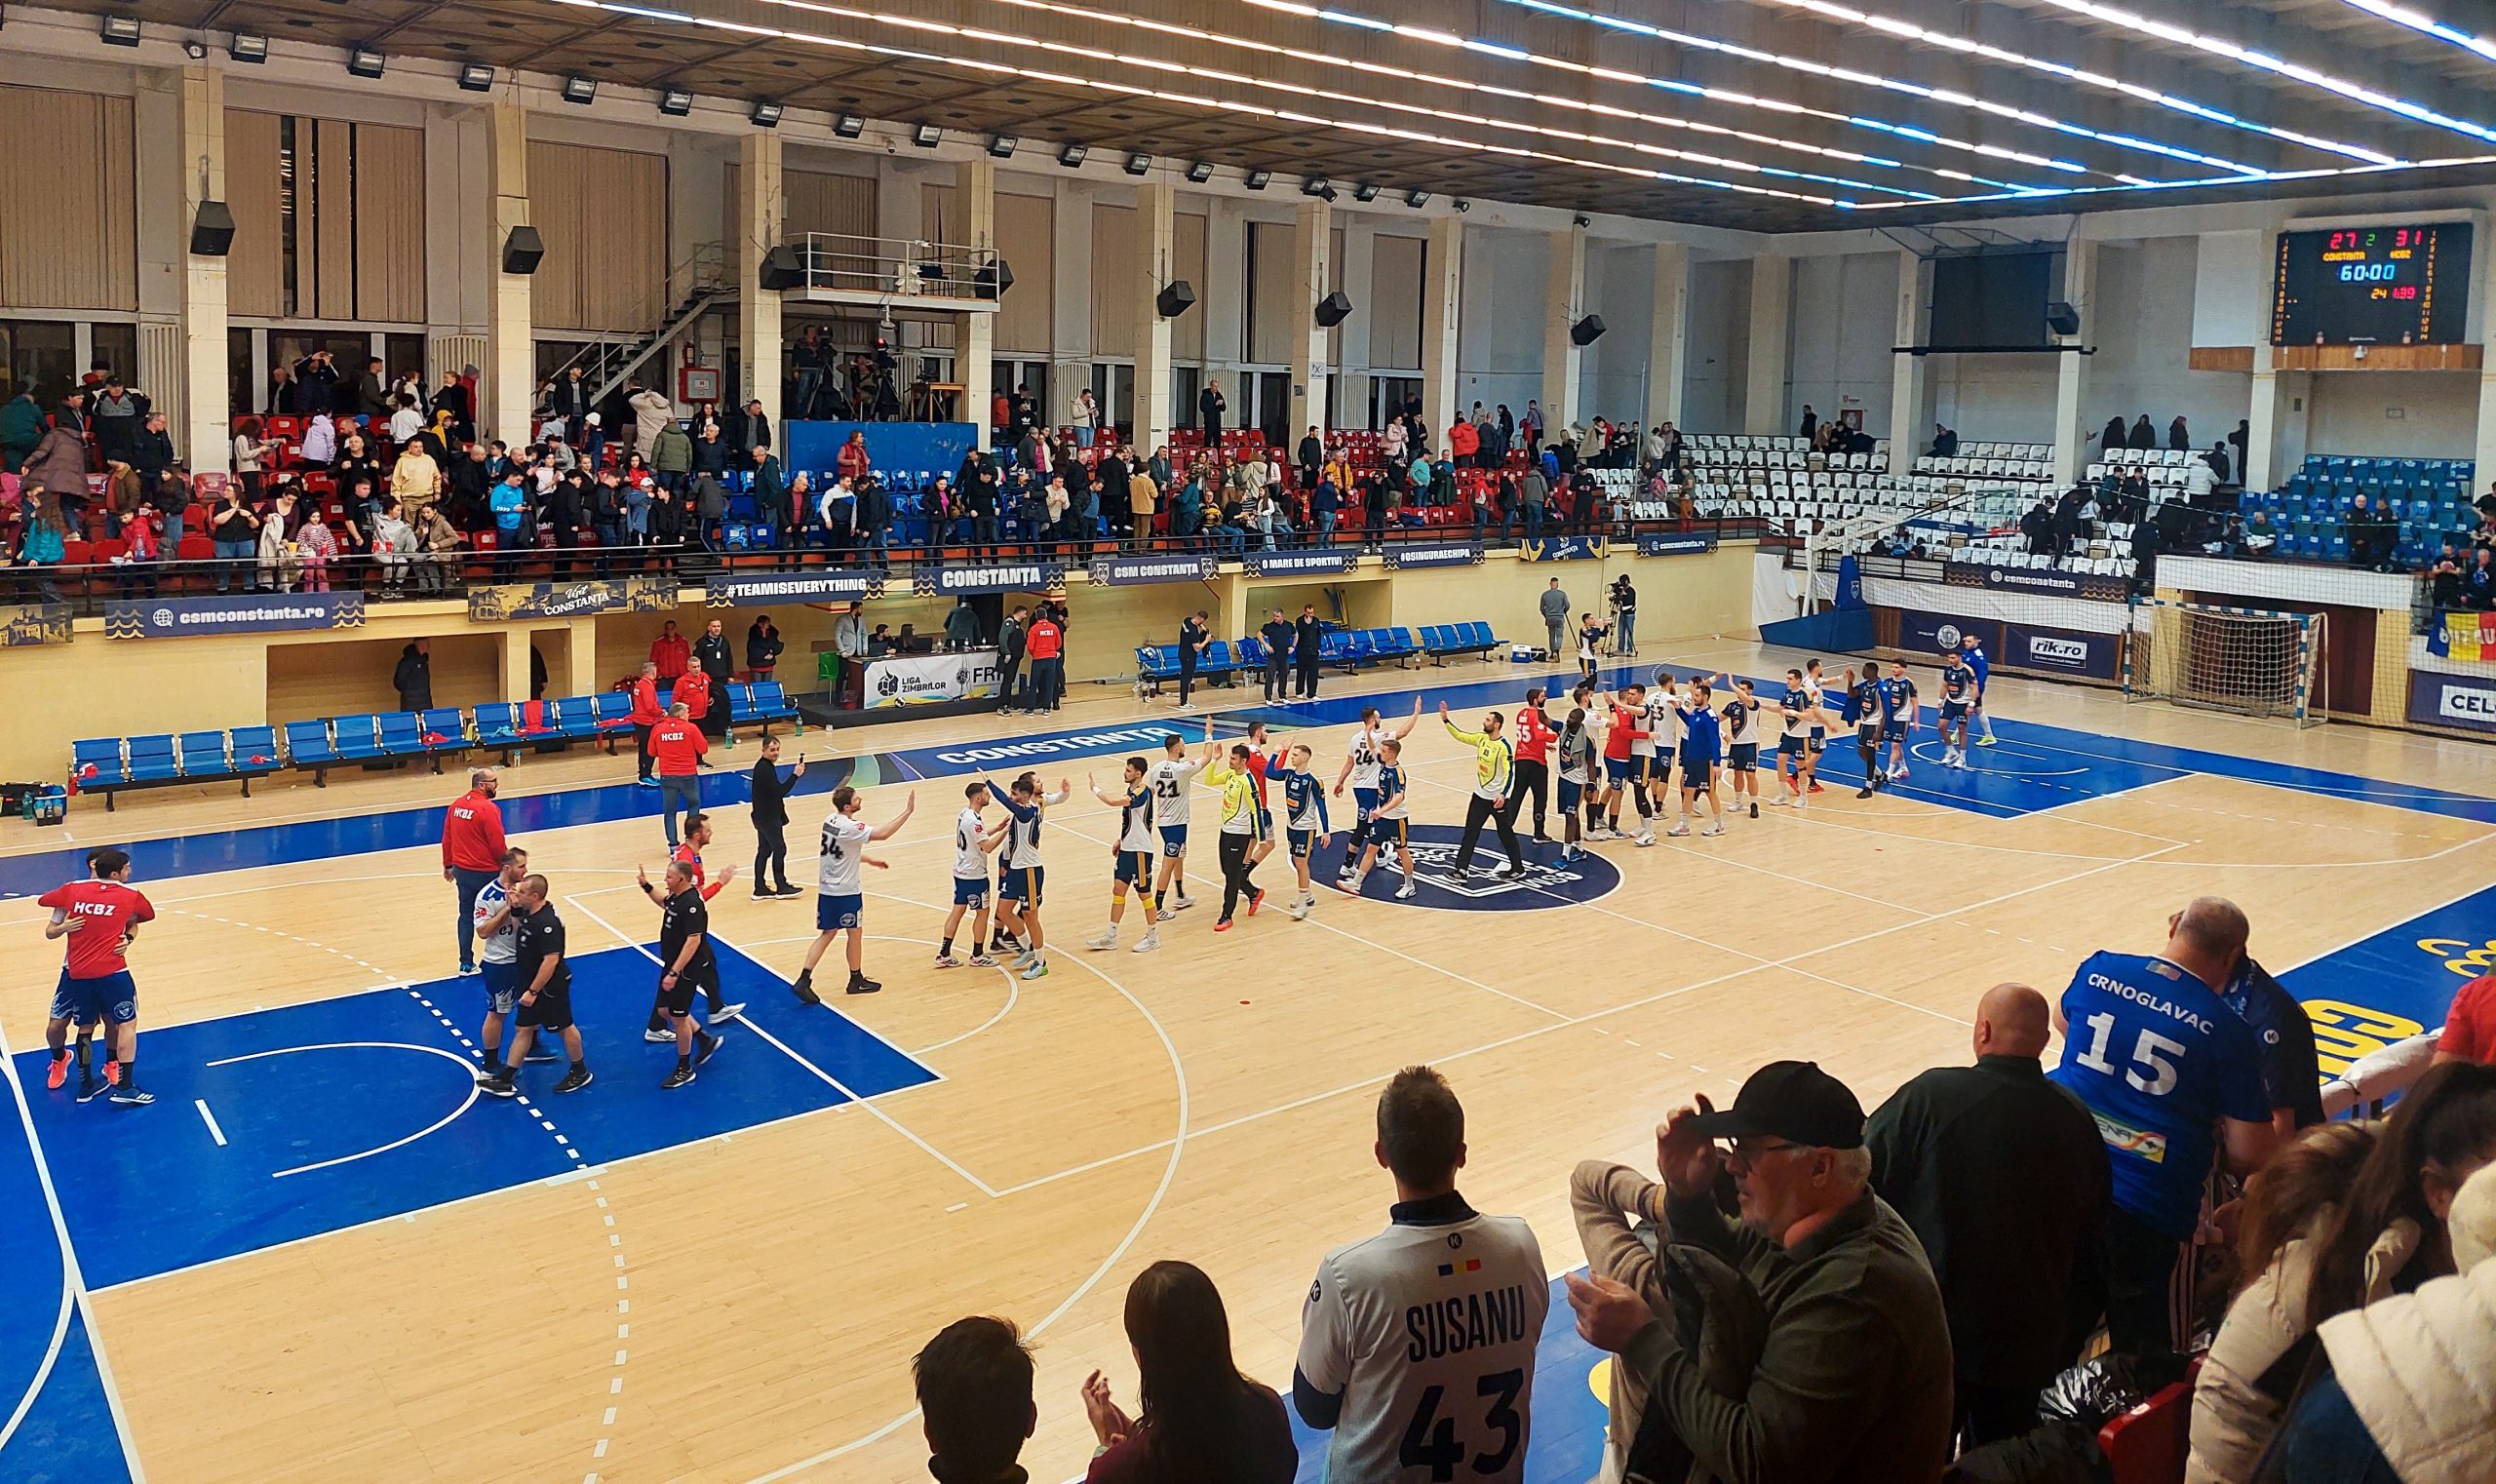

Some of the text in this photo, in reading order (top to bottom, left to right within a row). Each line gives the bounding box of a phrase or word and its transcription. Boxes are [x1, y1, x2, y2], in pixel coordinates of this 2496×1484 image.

[2329, 231, 2358, 250] 27
[2396, 229, 2423, 247] 31
[1262, 556, 1343, 569] O MARE DE SPORTIVI
[1400, 548, 1471, 563] #OSINGURAECHIPA
[943, 566, 1041, 588] CONSTANȚA
[1113, 563, 1199, 578] CSM CONSTANȚA
[726, 577, 867, 599] #TEAMISEVERYTHING
[179, 606, 326, 624] csmconstanta.ro
[2035, 640, 2082, 656] rik.ro
[902, 676, 921, 685] LIGA
[2451, 694, 2496, 715] CEL
[661, 731, 684, 742] HCBZ
[936, 726, 1182, 764] CONSTANȚA
[1355, 749, 1375, 765] 24
[1155, 780, 1181, 798] 21
[453, 806, 475, 820] HCBZ
[820, 832, 843, 860] 34
[73, 901, 117, 917] HCBZ
[2087, 972, 2215, 1036] CRNOGLAVAC
[2075, 1011, 2187, 1097] 15
[1406, 1284, 1526, 1363] SUSANU
[1398, 1367, 1525, 1483] 43
